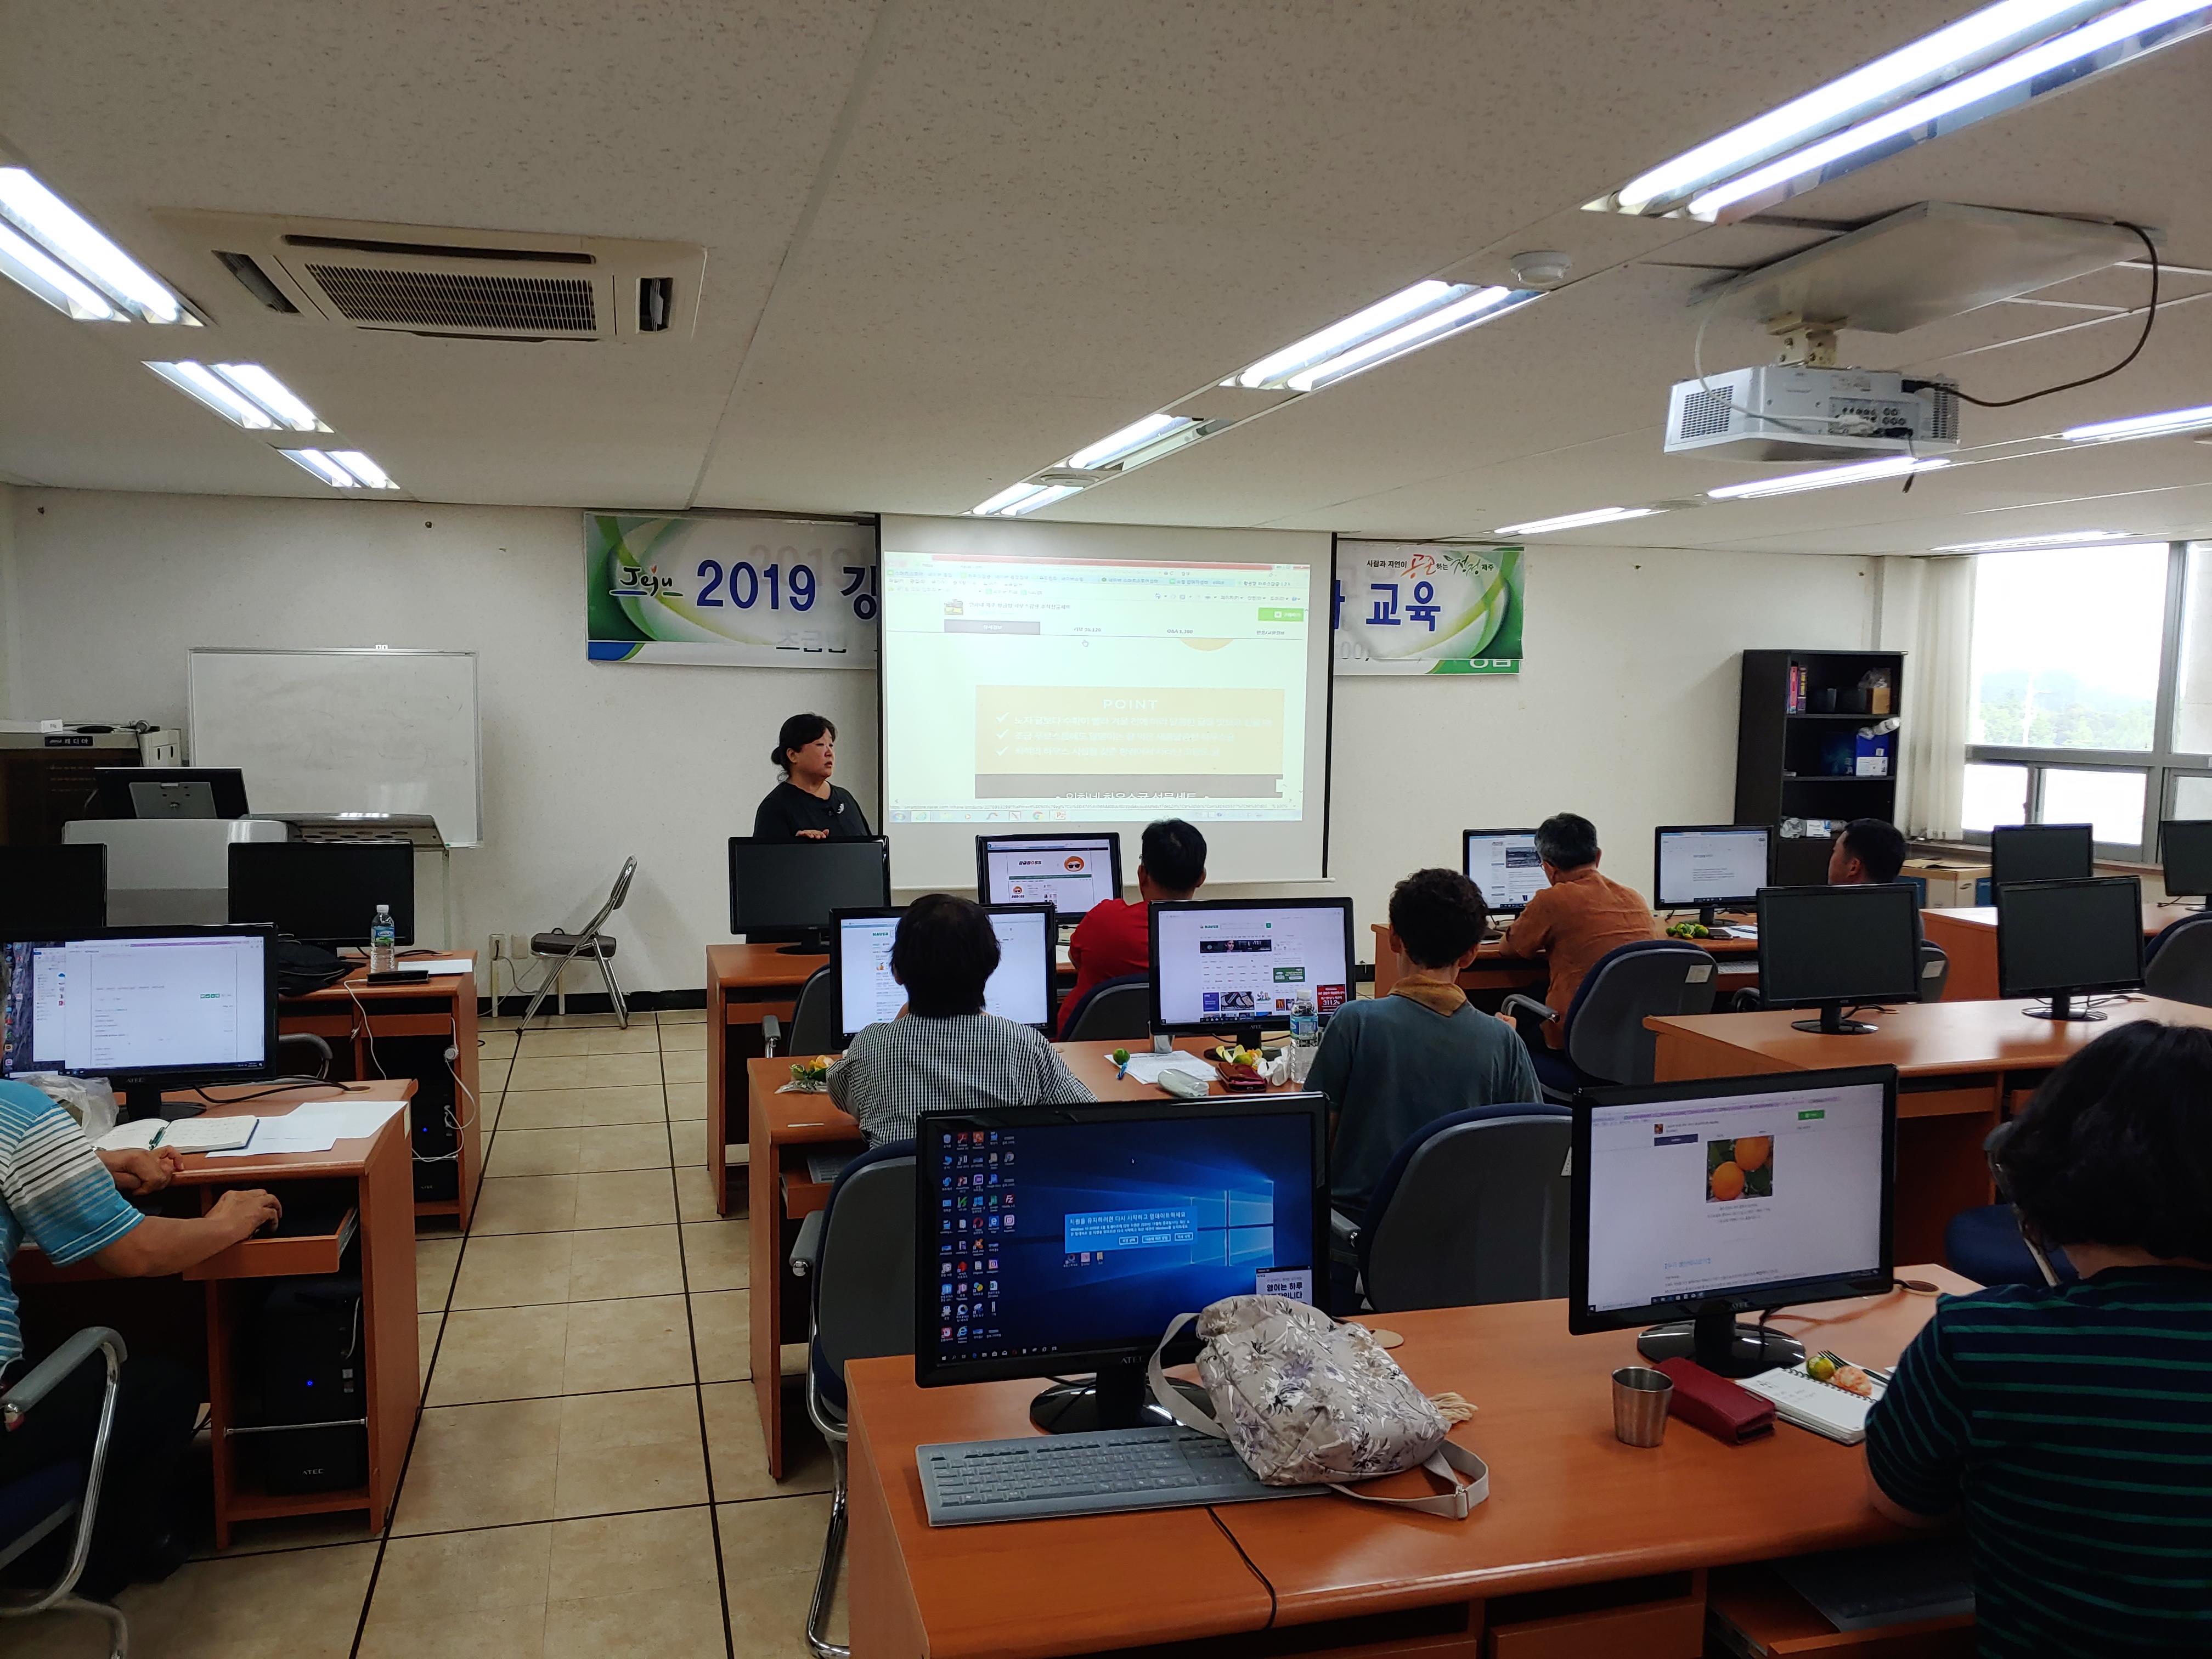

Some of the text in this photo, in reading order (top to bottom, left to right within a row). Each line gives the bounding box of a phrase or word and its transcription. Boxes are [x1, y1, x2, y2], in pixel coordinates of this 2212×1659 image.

[620, 566, 673, 596] Jeju
[696, 560, 816, 611] 2019
[1365, 580, 1441, 631] 교육
[1103, 699, 1158, 710] POINT
[1289, 1282, 1302, 1290] 하루
